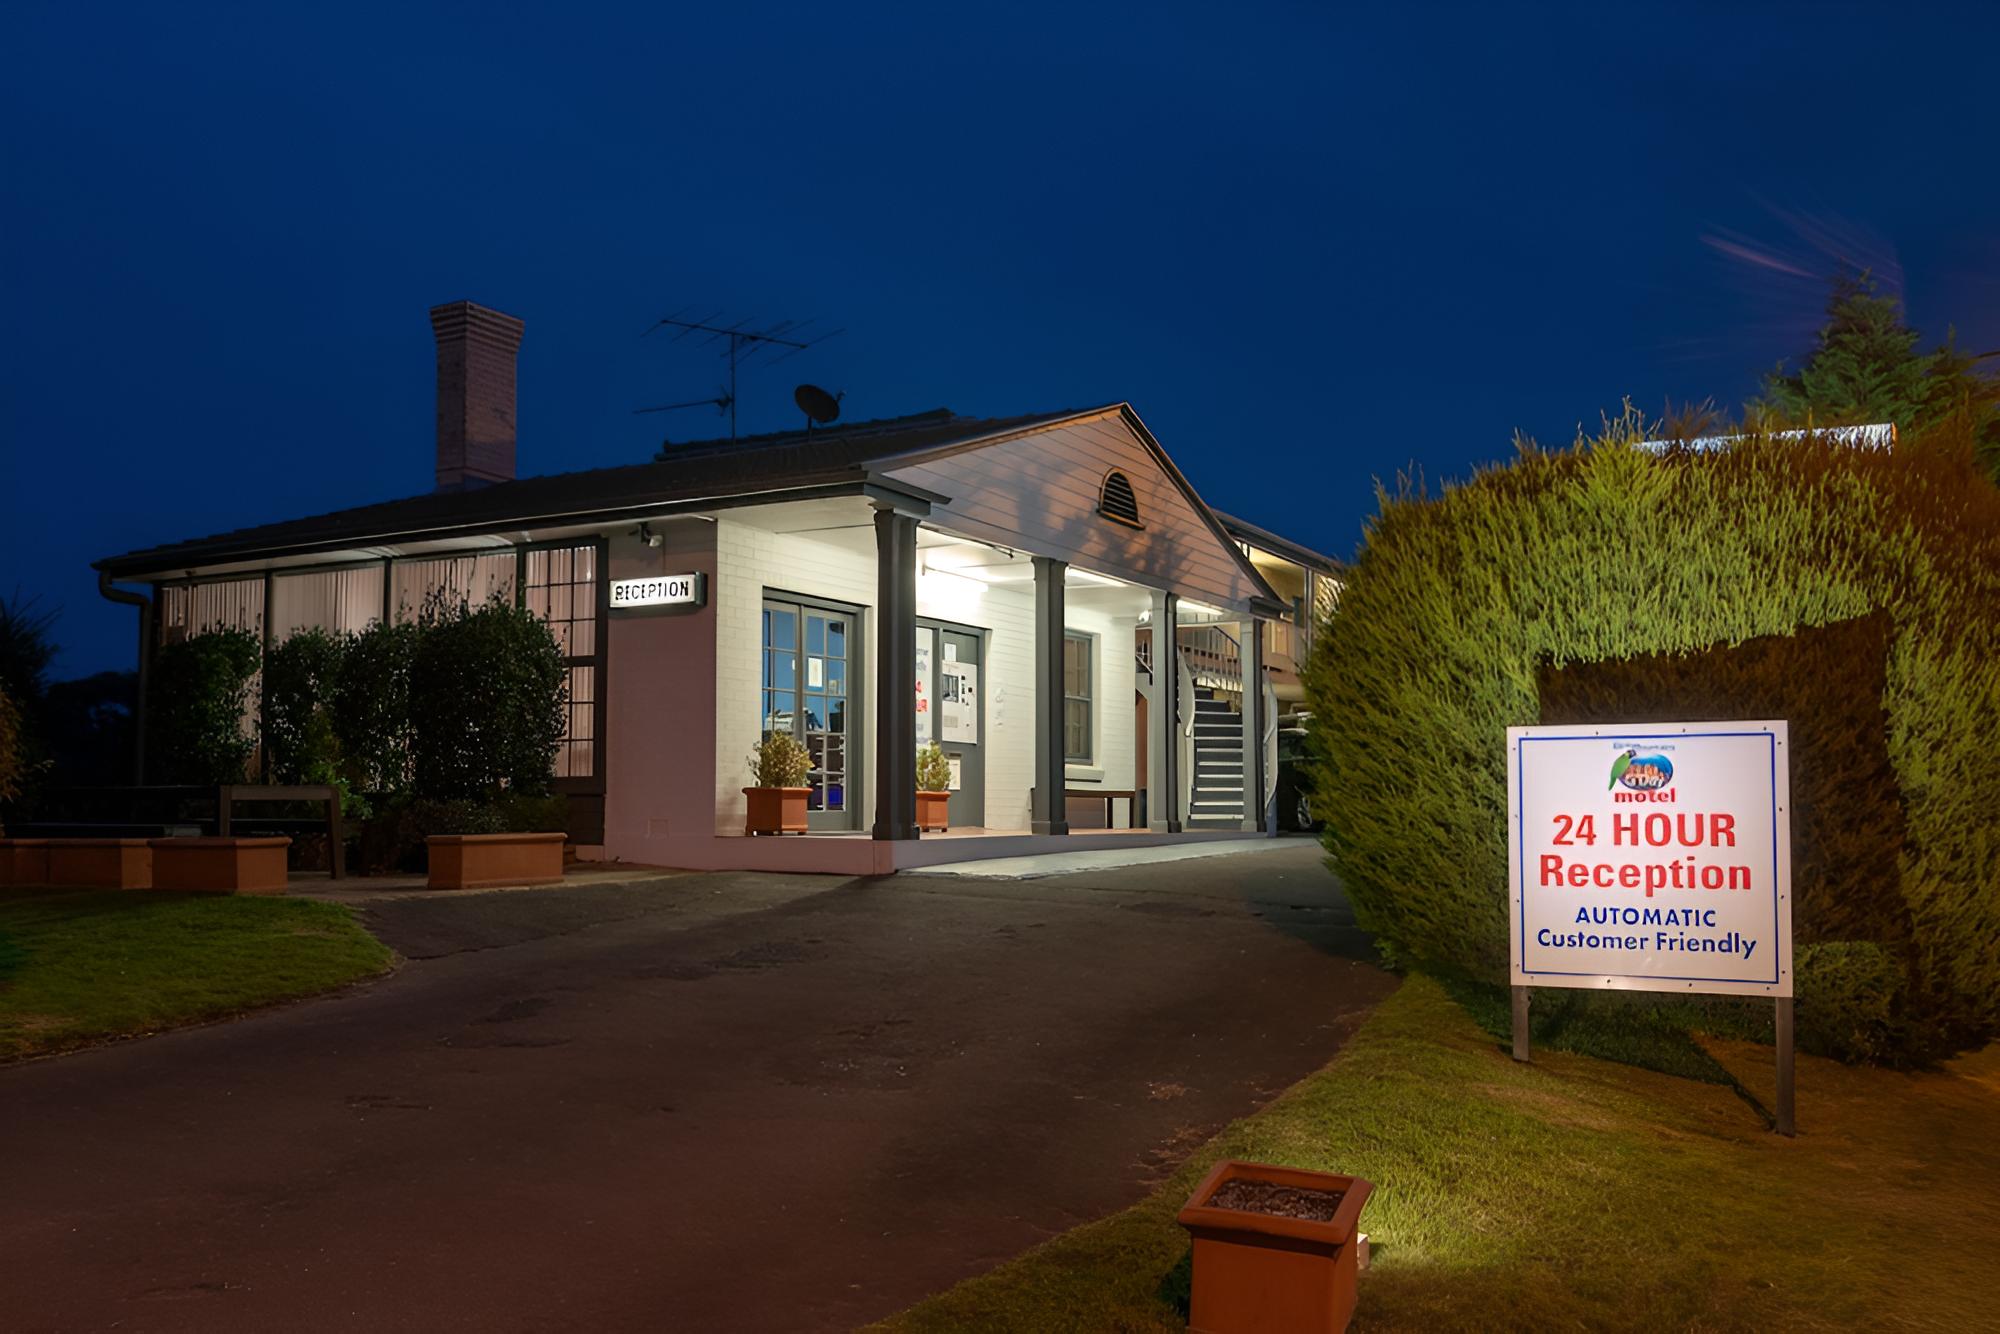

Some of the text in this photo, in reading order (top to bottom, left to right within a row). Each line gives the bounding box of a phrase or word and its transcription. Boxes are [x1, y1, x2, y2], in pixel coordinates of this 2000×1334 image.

[615, 581, 689, 601] RECEPTION
[1614, 787, 1676, 803] motel
[1552, 812, 1736, 847] 24 HOUR
[1540, 854, 1751, 897] Reception
[1575, 906, 1716, 927] AUTOMATIC
[1537, 928, 1757, 960] Customer Friendly
